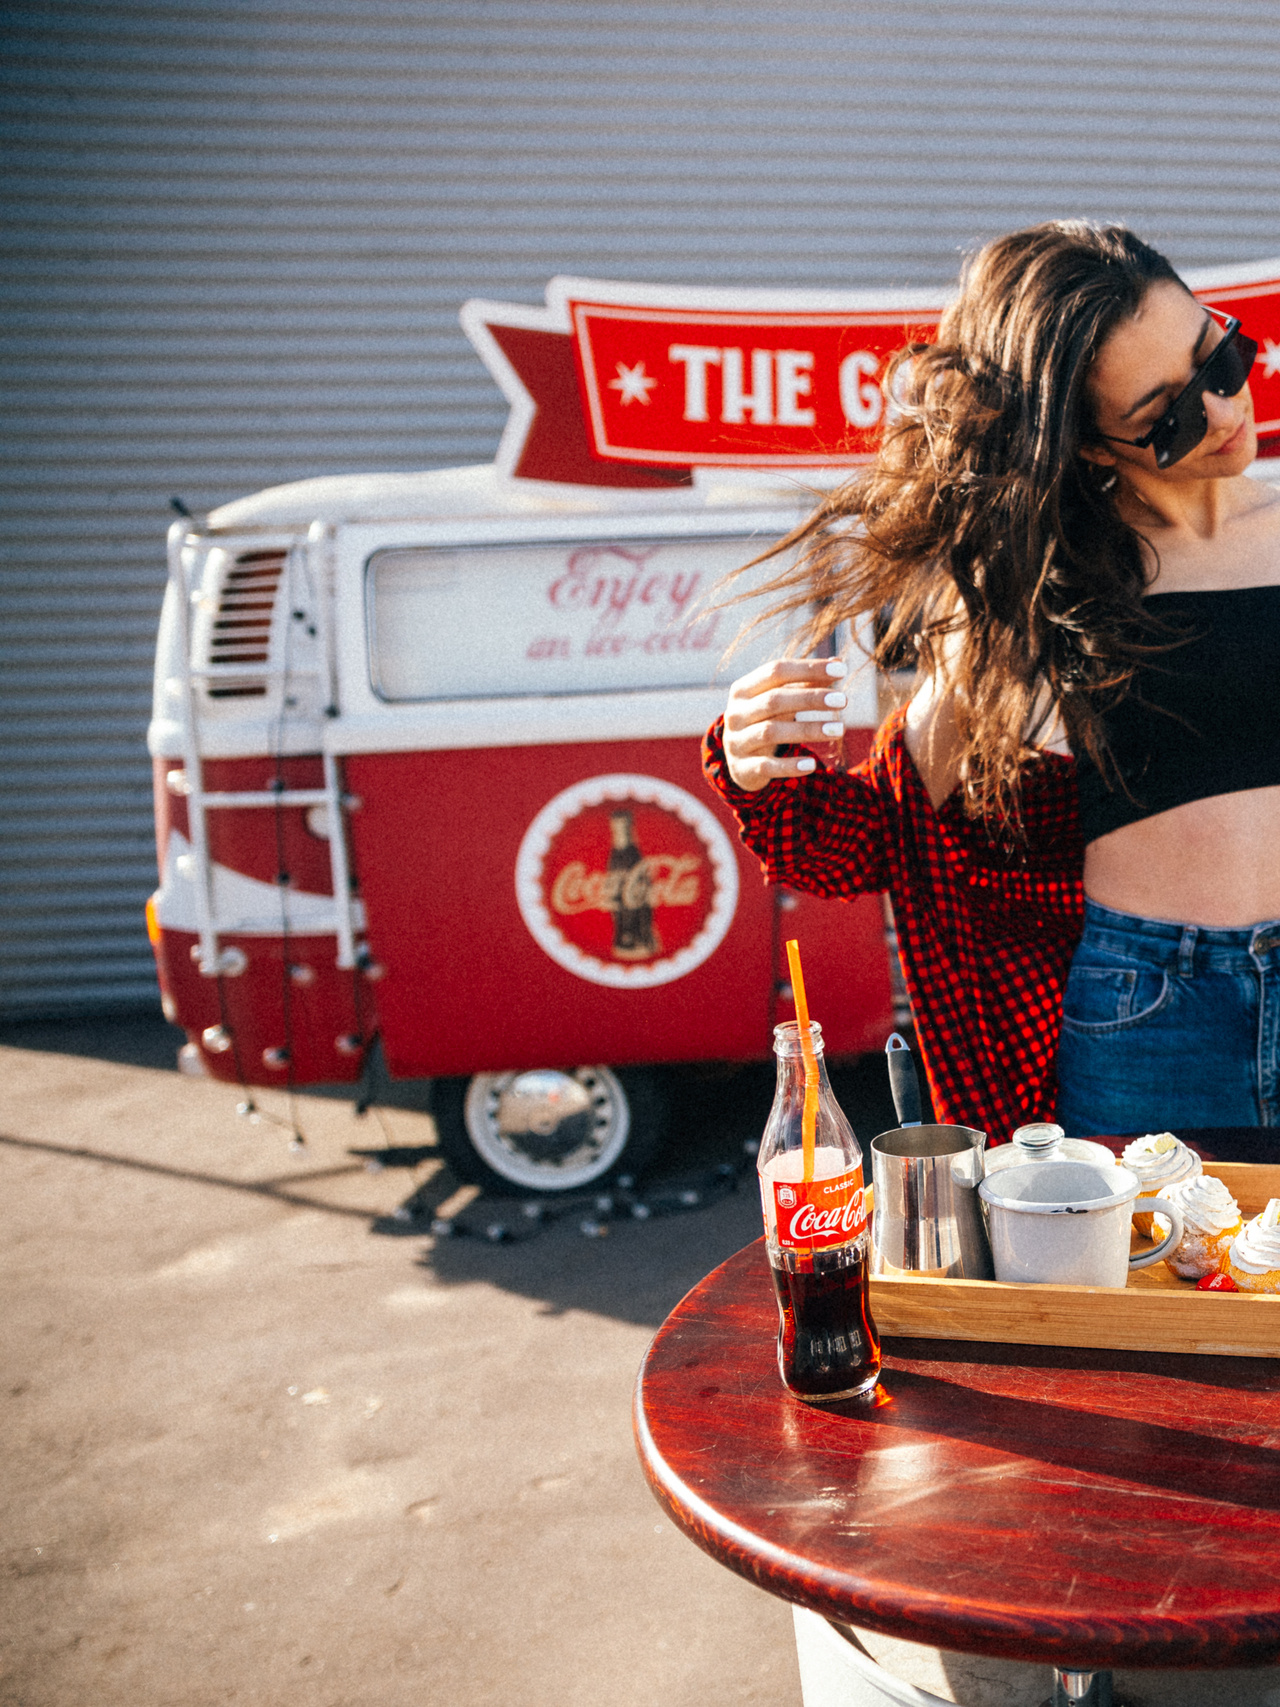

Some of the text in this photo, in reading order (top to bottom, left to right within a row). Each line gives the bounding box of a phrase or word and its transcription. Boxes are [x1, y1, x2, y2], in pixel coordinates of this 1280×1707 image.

[669, 344, 815, 427] THE
[547, 545, 703, 632] Enjoy
[789, 1187, 867, 1239] Coca-Col
[823, 1179, 854, 1194] CLASSIC
